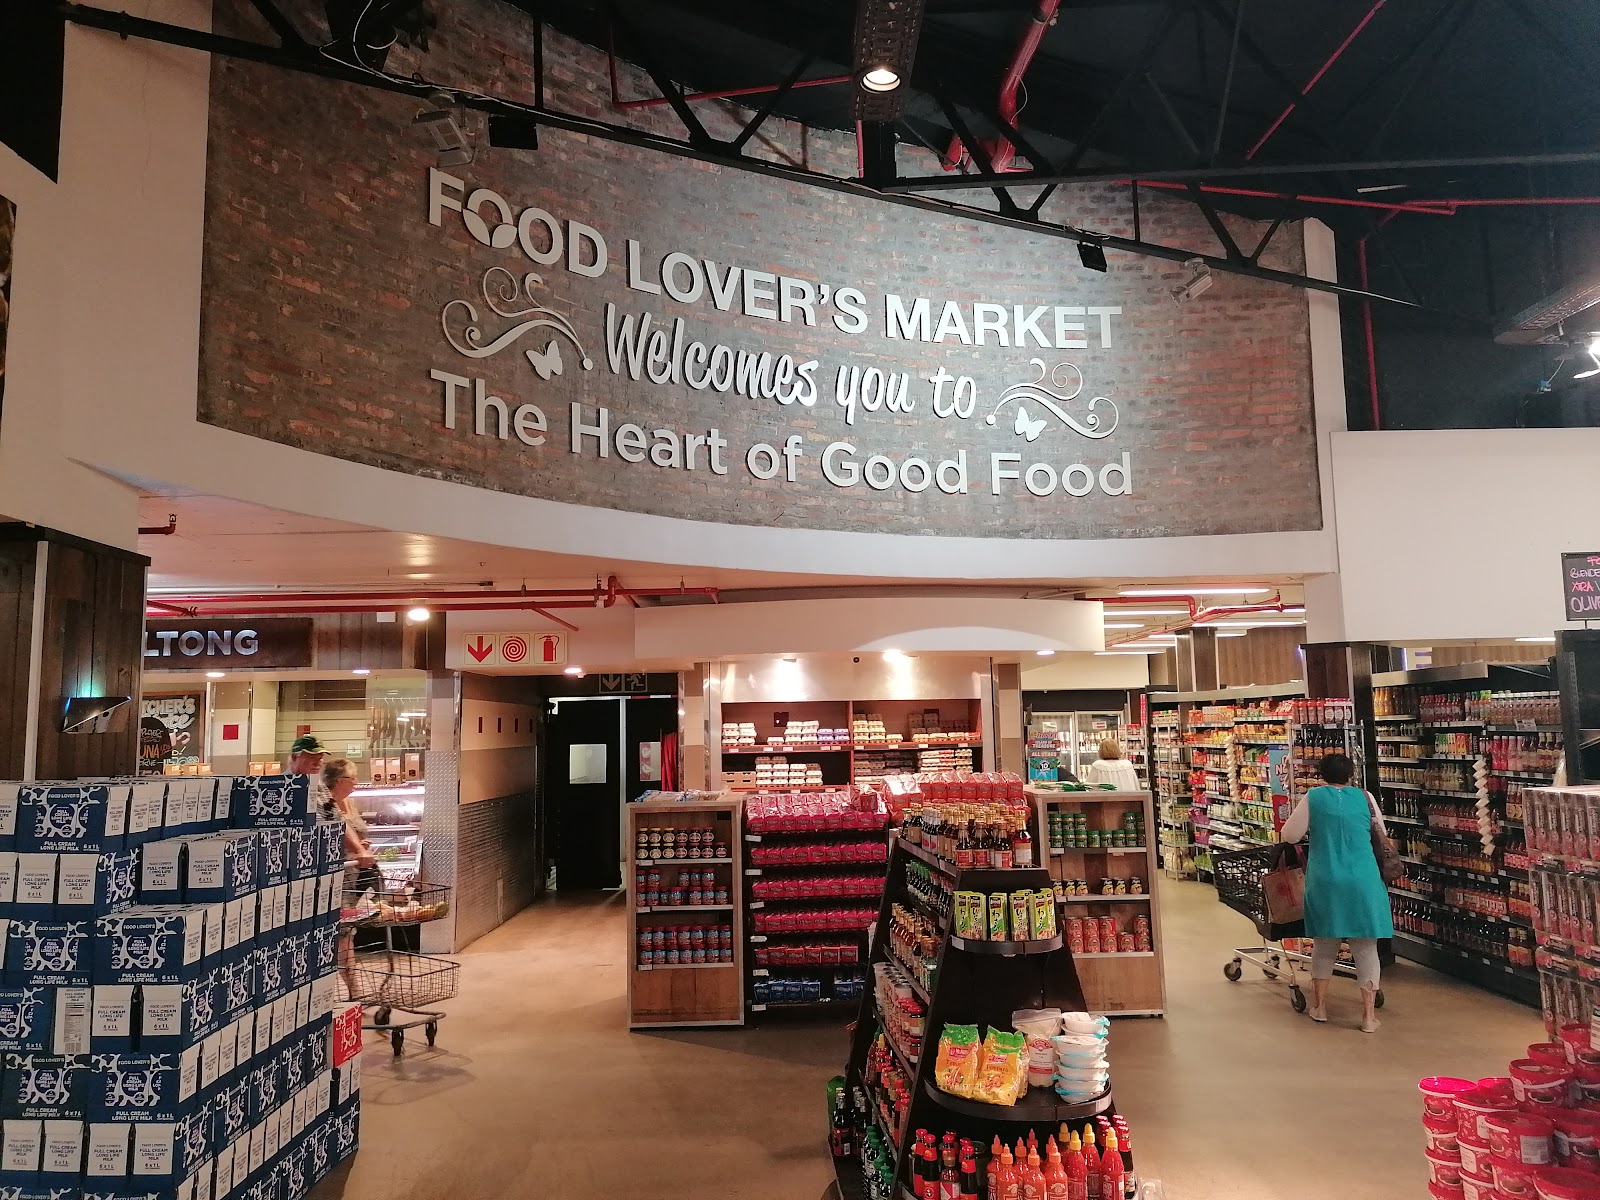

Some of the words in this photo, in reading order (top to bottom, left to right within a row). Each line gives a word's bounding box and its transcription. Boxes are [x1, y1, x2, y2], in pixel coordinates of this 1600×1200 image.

[428, 166, 608, 278] FOOD
[627, 239, 868, 335] LOVER'S
[885, 293, 1122, 350] MARKET
[604, 302, 819, 408] Welcomes
[835, 362, 916, 425] you
[928, 362, 977, 420] to
[430, 367, 547, 447] The
[570, 399, 727, 475] Heart
[747, 433, 803, 483] of
[821, 440, 968, 496] Good
[990, 451, 1133, 496] Food
